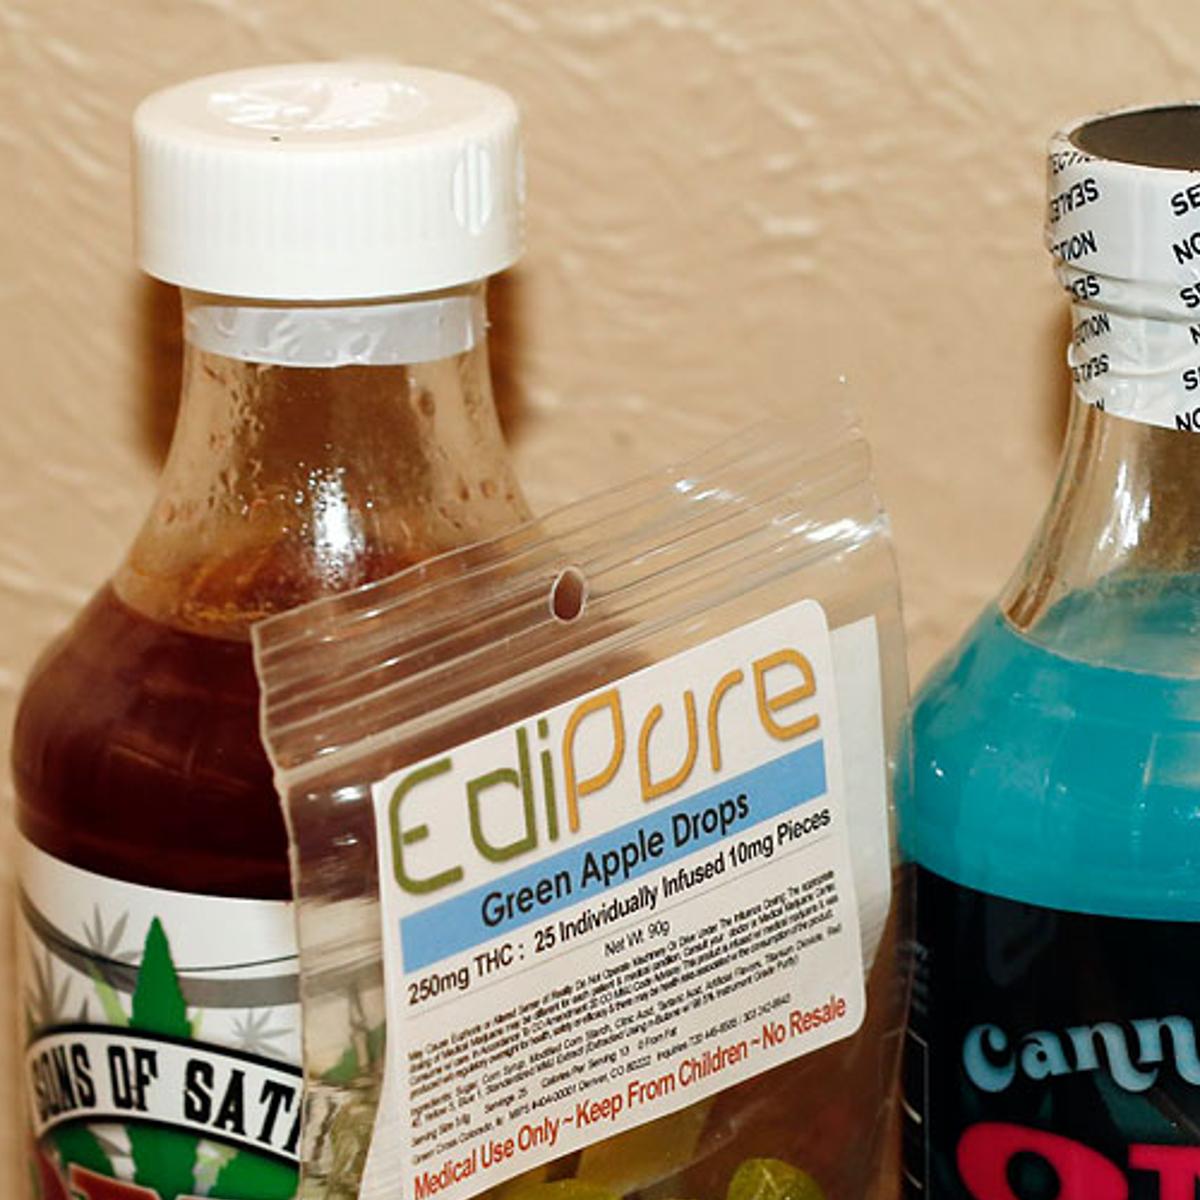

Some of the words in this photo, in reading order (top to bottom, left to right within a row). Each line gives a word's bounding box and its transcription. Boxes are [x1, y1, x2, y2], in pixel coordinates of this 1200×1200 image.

[389, 648, 820, 895] EdiPure
[408, 966, 470, 1006] 250mg
[474, 944, 514, 977] THC
[534, 925, 556, 954] 25
[559, 884, 658, 942] Individually
[661, 855, 725, 898] Infused
[727, 834, 774, 873] 10mg
[777, 808, 831, 841] Pieces
[481, 870, 572, 927] Green
[581, 829, 665, 887] Apple
[672, 791, 750, 856] Drops
[604, 934, 626, 958] Net
[647, 919, 670, 939] 90g
[32, 1043, 97, 1122] SONS
[107, 1045, 158, 1112] OF
[184, 1057, 300, 1154] SAT
[480, 1137, 515, 1170] Use
[517, 1116, 560, 1151] Only
[576, 1096, 623, 1129] Keep
[627, 1073, 676, 1110] From
[678, 1039, 748, 1089] Children
[762, 1022, 787, 1050] No
[788, 994, 847, 1039] Resale
